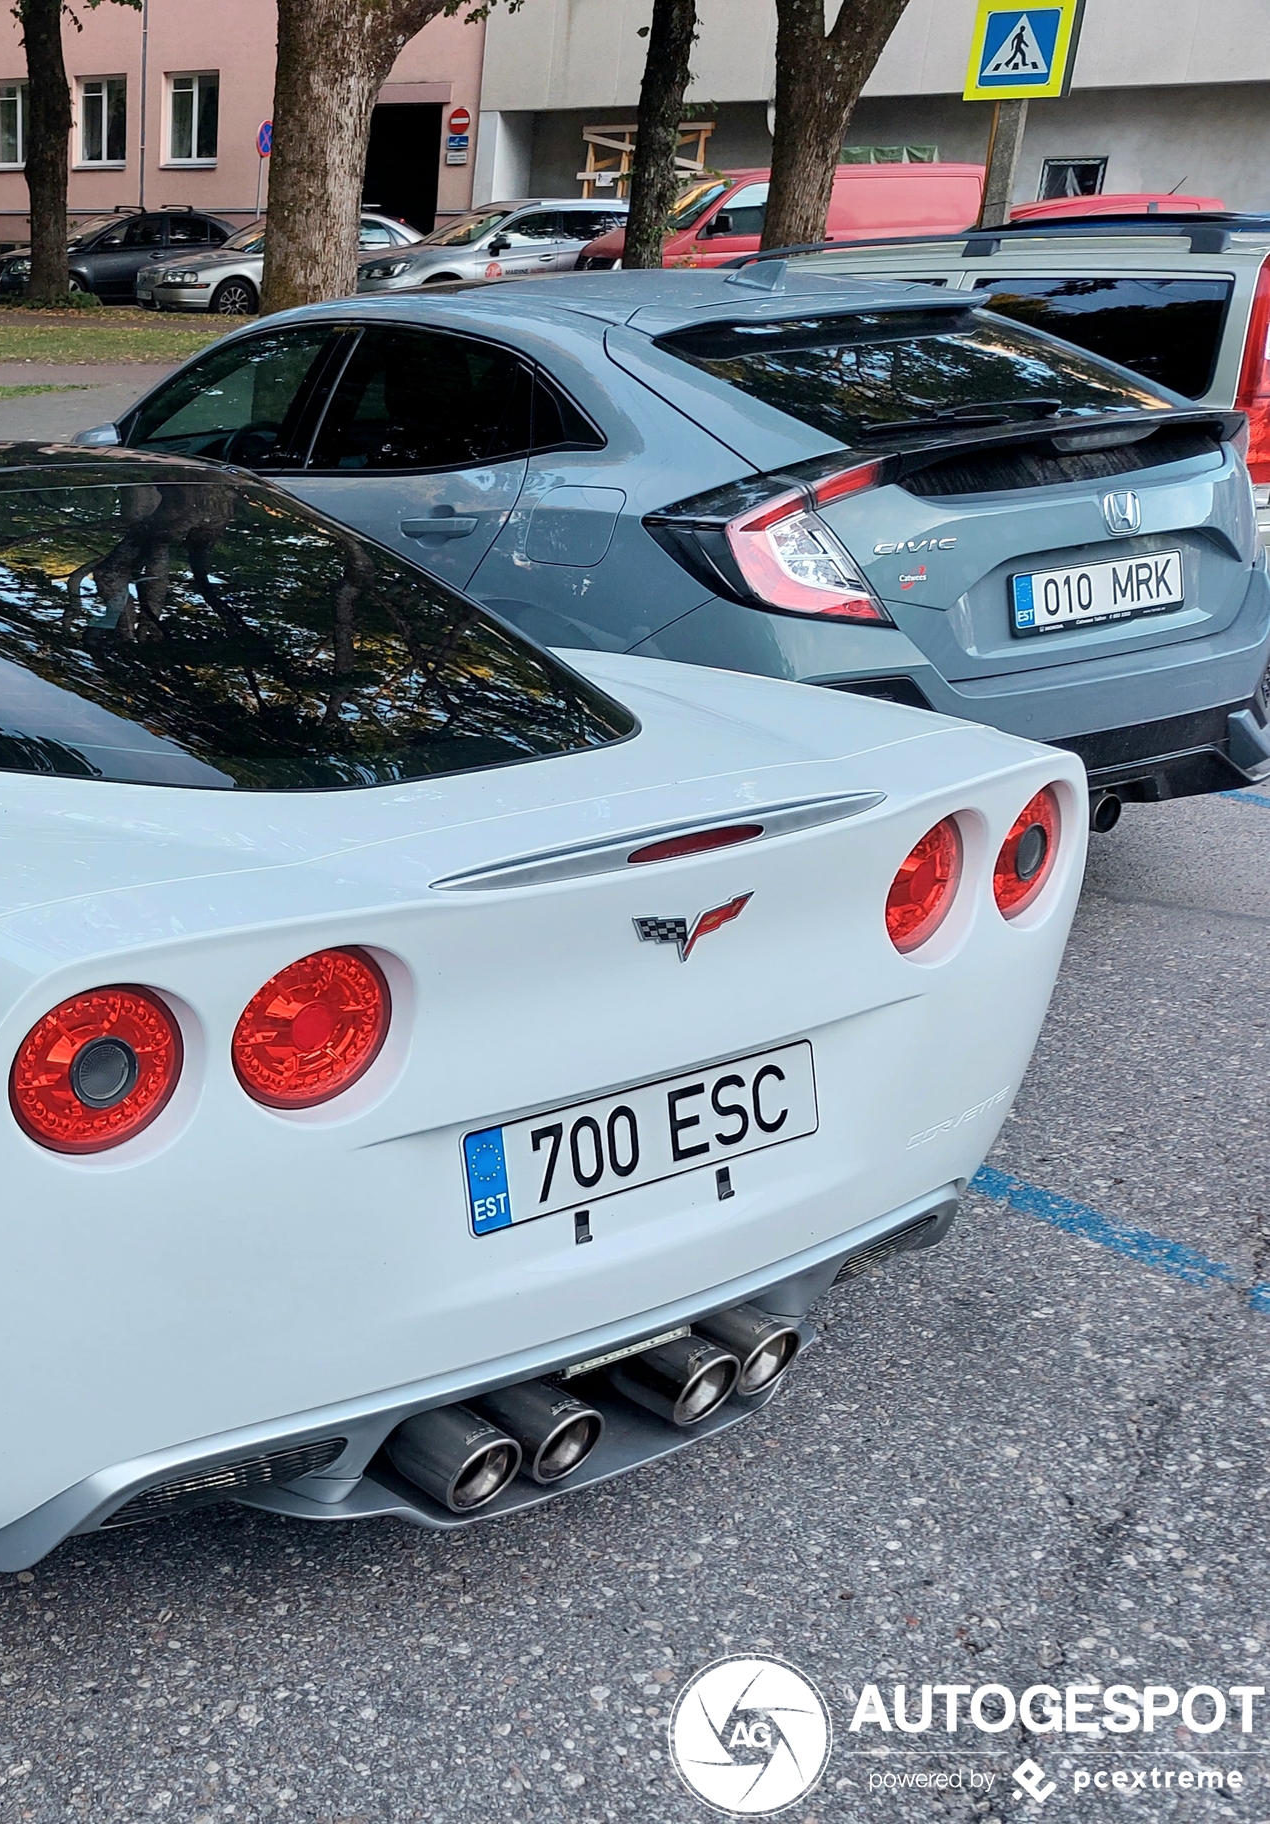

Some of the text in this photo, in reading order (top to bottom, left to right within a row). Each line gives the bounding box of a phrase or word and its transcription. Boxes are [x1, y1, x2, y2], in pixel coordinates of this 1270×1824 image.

[873, 537, 958, 556] CIVIC
[1043, 558, 1174, 616] 010 MRK
[1017, 607, 1035, 623] EST
[530, 1064, 788, 1203] 700 ESC
[905, 1085, 1011, 1151] CORVETTE
[473, 1192, 508, 1222] EST
